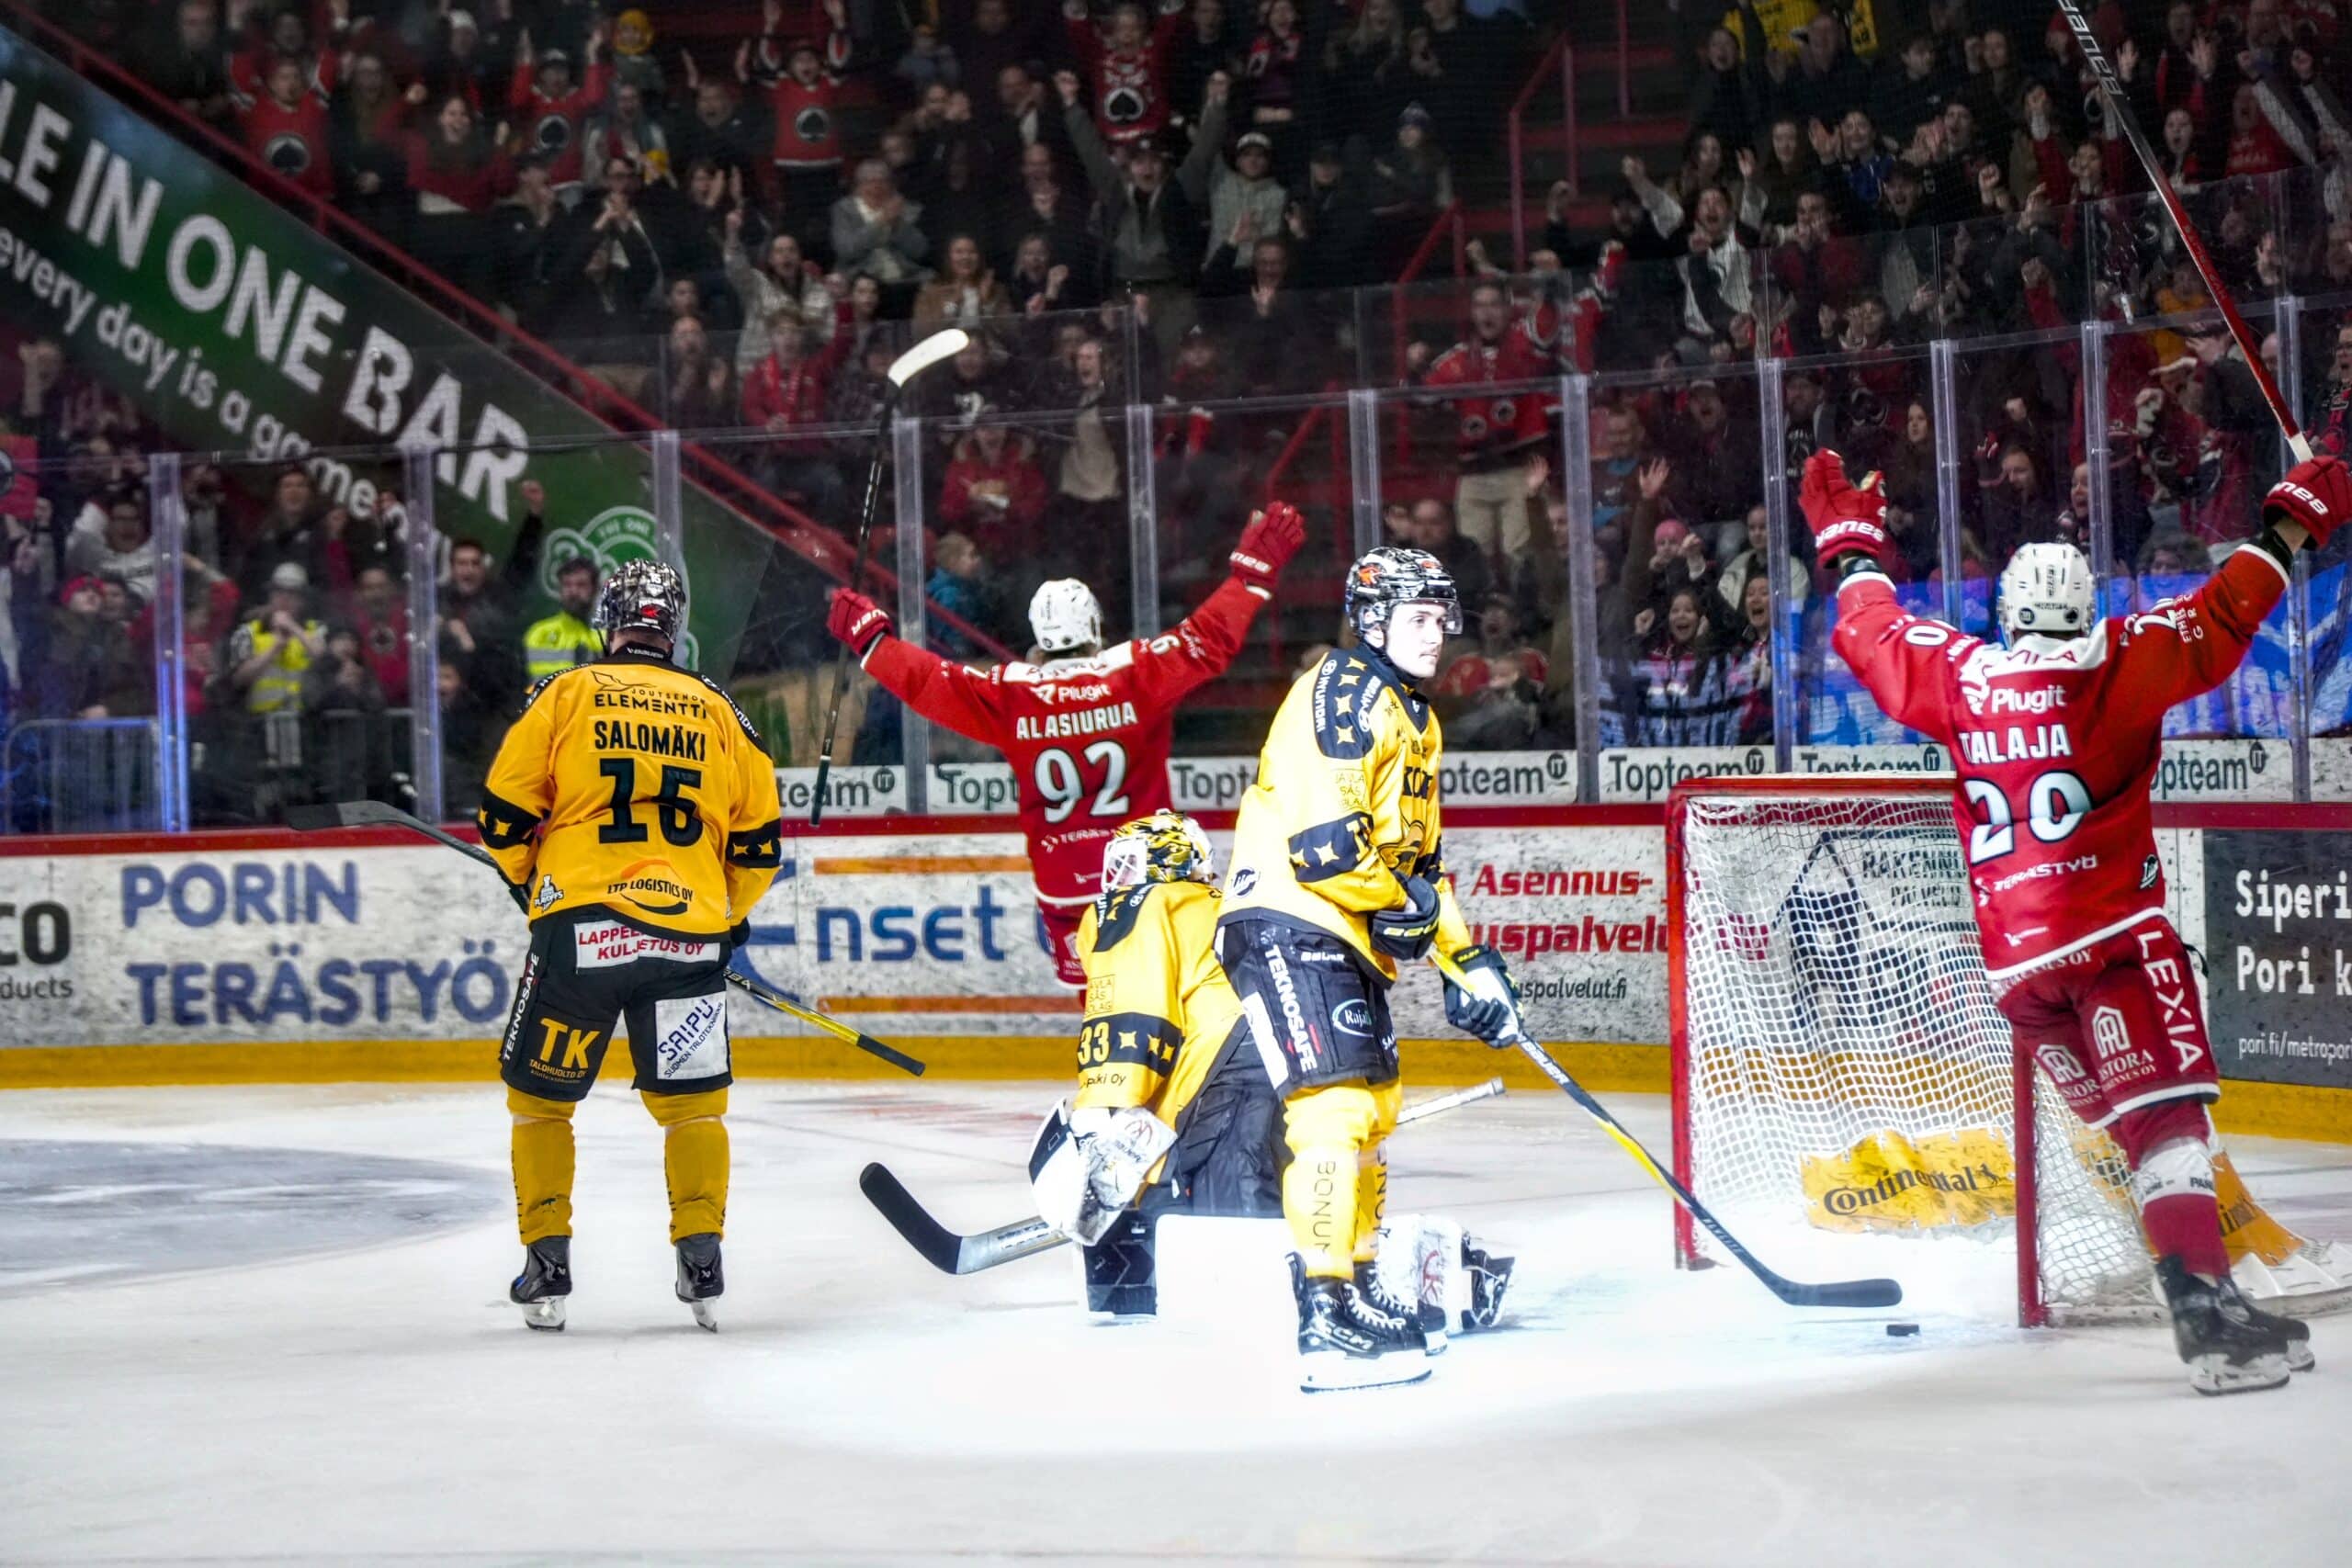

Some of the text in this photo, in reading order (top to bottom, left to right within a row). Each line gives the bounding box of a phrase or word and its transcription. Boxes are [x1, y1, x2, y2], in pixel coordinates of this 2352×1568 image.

[66, 139, 164, 271] IN
[165, 213, 347, 394] ONE
[343, 325, 529, 522] BAR
[0, 227, 378, 520] every day is a game
[594, 693, 707, 719] ELEMENTTI
[1016, 701, 1138, 740] ALASIURUA
[1990, 683, 2067, 714] Plugit
[594, 719, 707, 762] SALOMÄKI
[938, 767, 1018, 811] Topt
[1034, 740, 1130, 824] 92
[1172, 763, 1251, 807] Topt
[1440, 756, 1544, 802] pteam
[2151, 750, 2248, 800] pteam
[598, 757, 705, 847] 15
[1963, 770, 2095, 865] 20
[120, 860, 360, 929] PORIN
[629, 878, 681, 898] LOGISTICS
[682, 886, 694, 902] OY
[1470, 863, 1654, 897] Asennus-
[578, 925, 645, 946] LAPPEE
[596, 939, 706, 961] KULJETUS OY
[2070, 947, 2093, 965] OY
[125, 937, 511, 1027] TERÄSTYÖ
[2236, 945, 2315, 995] Pori
[503, 952, 539, 1061] TEKNOSAFE
[1263, 944, 1318, 1073] TEKNOSAFE
[2137, 930, 2204, 1073] LEXIA
[540, 1017, 602, 1070] TK
[658, 998, 714, 1062] SAIPU
[1077, 1021, 1110, 1066] 33
[1824, 1166, 1977, 1216] Continental
